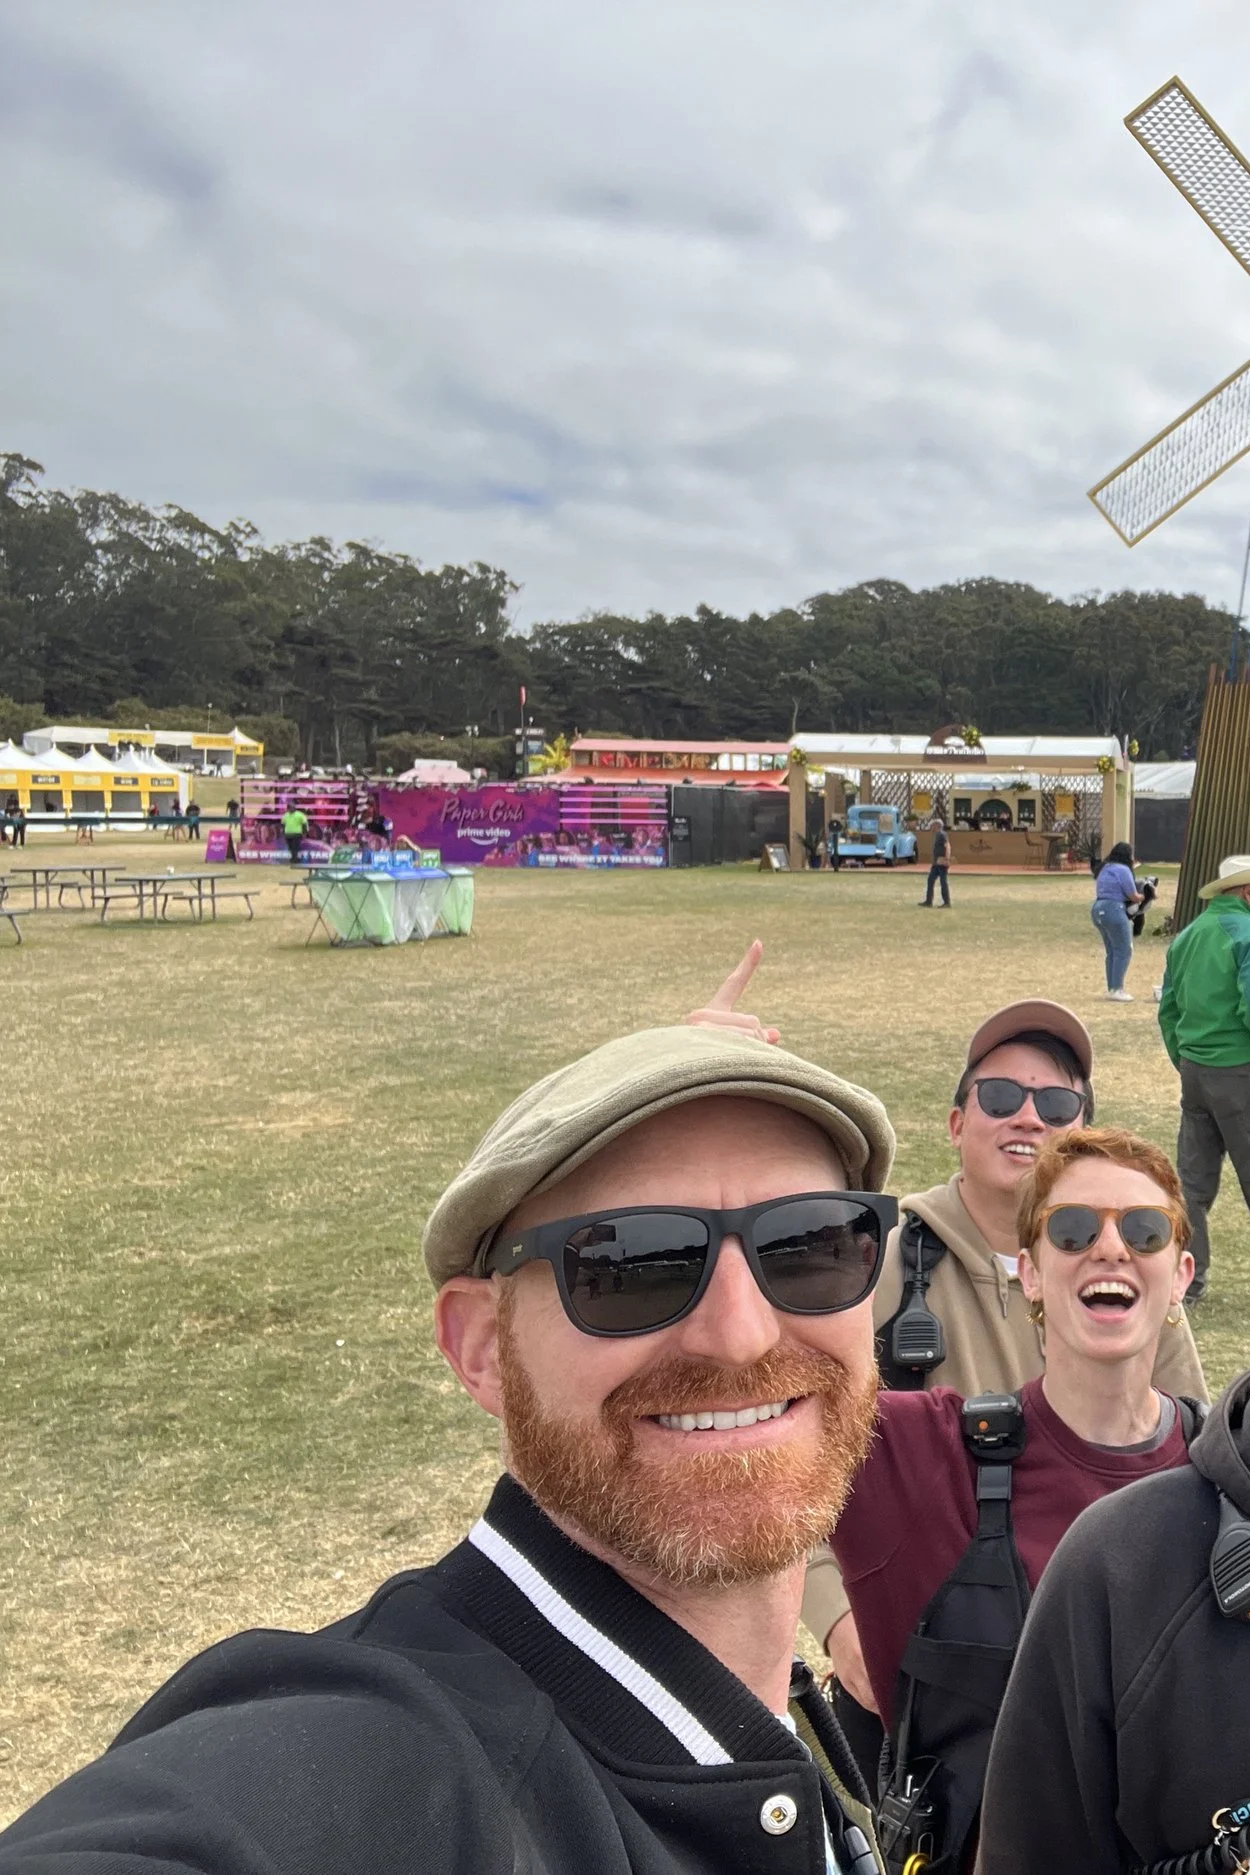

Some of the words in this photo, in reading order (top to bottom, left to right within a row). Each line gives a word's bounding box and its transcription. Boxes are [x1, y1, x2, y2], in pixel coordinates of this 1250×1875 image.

[440, 797, 486, 829] Paper
[487, 798, 525, 823] Girls
[457, 827, 484, 838] prime
[486, 826, 511, 838] video
